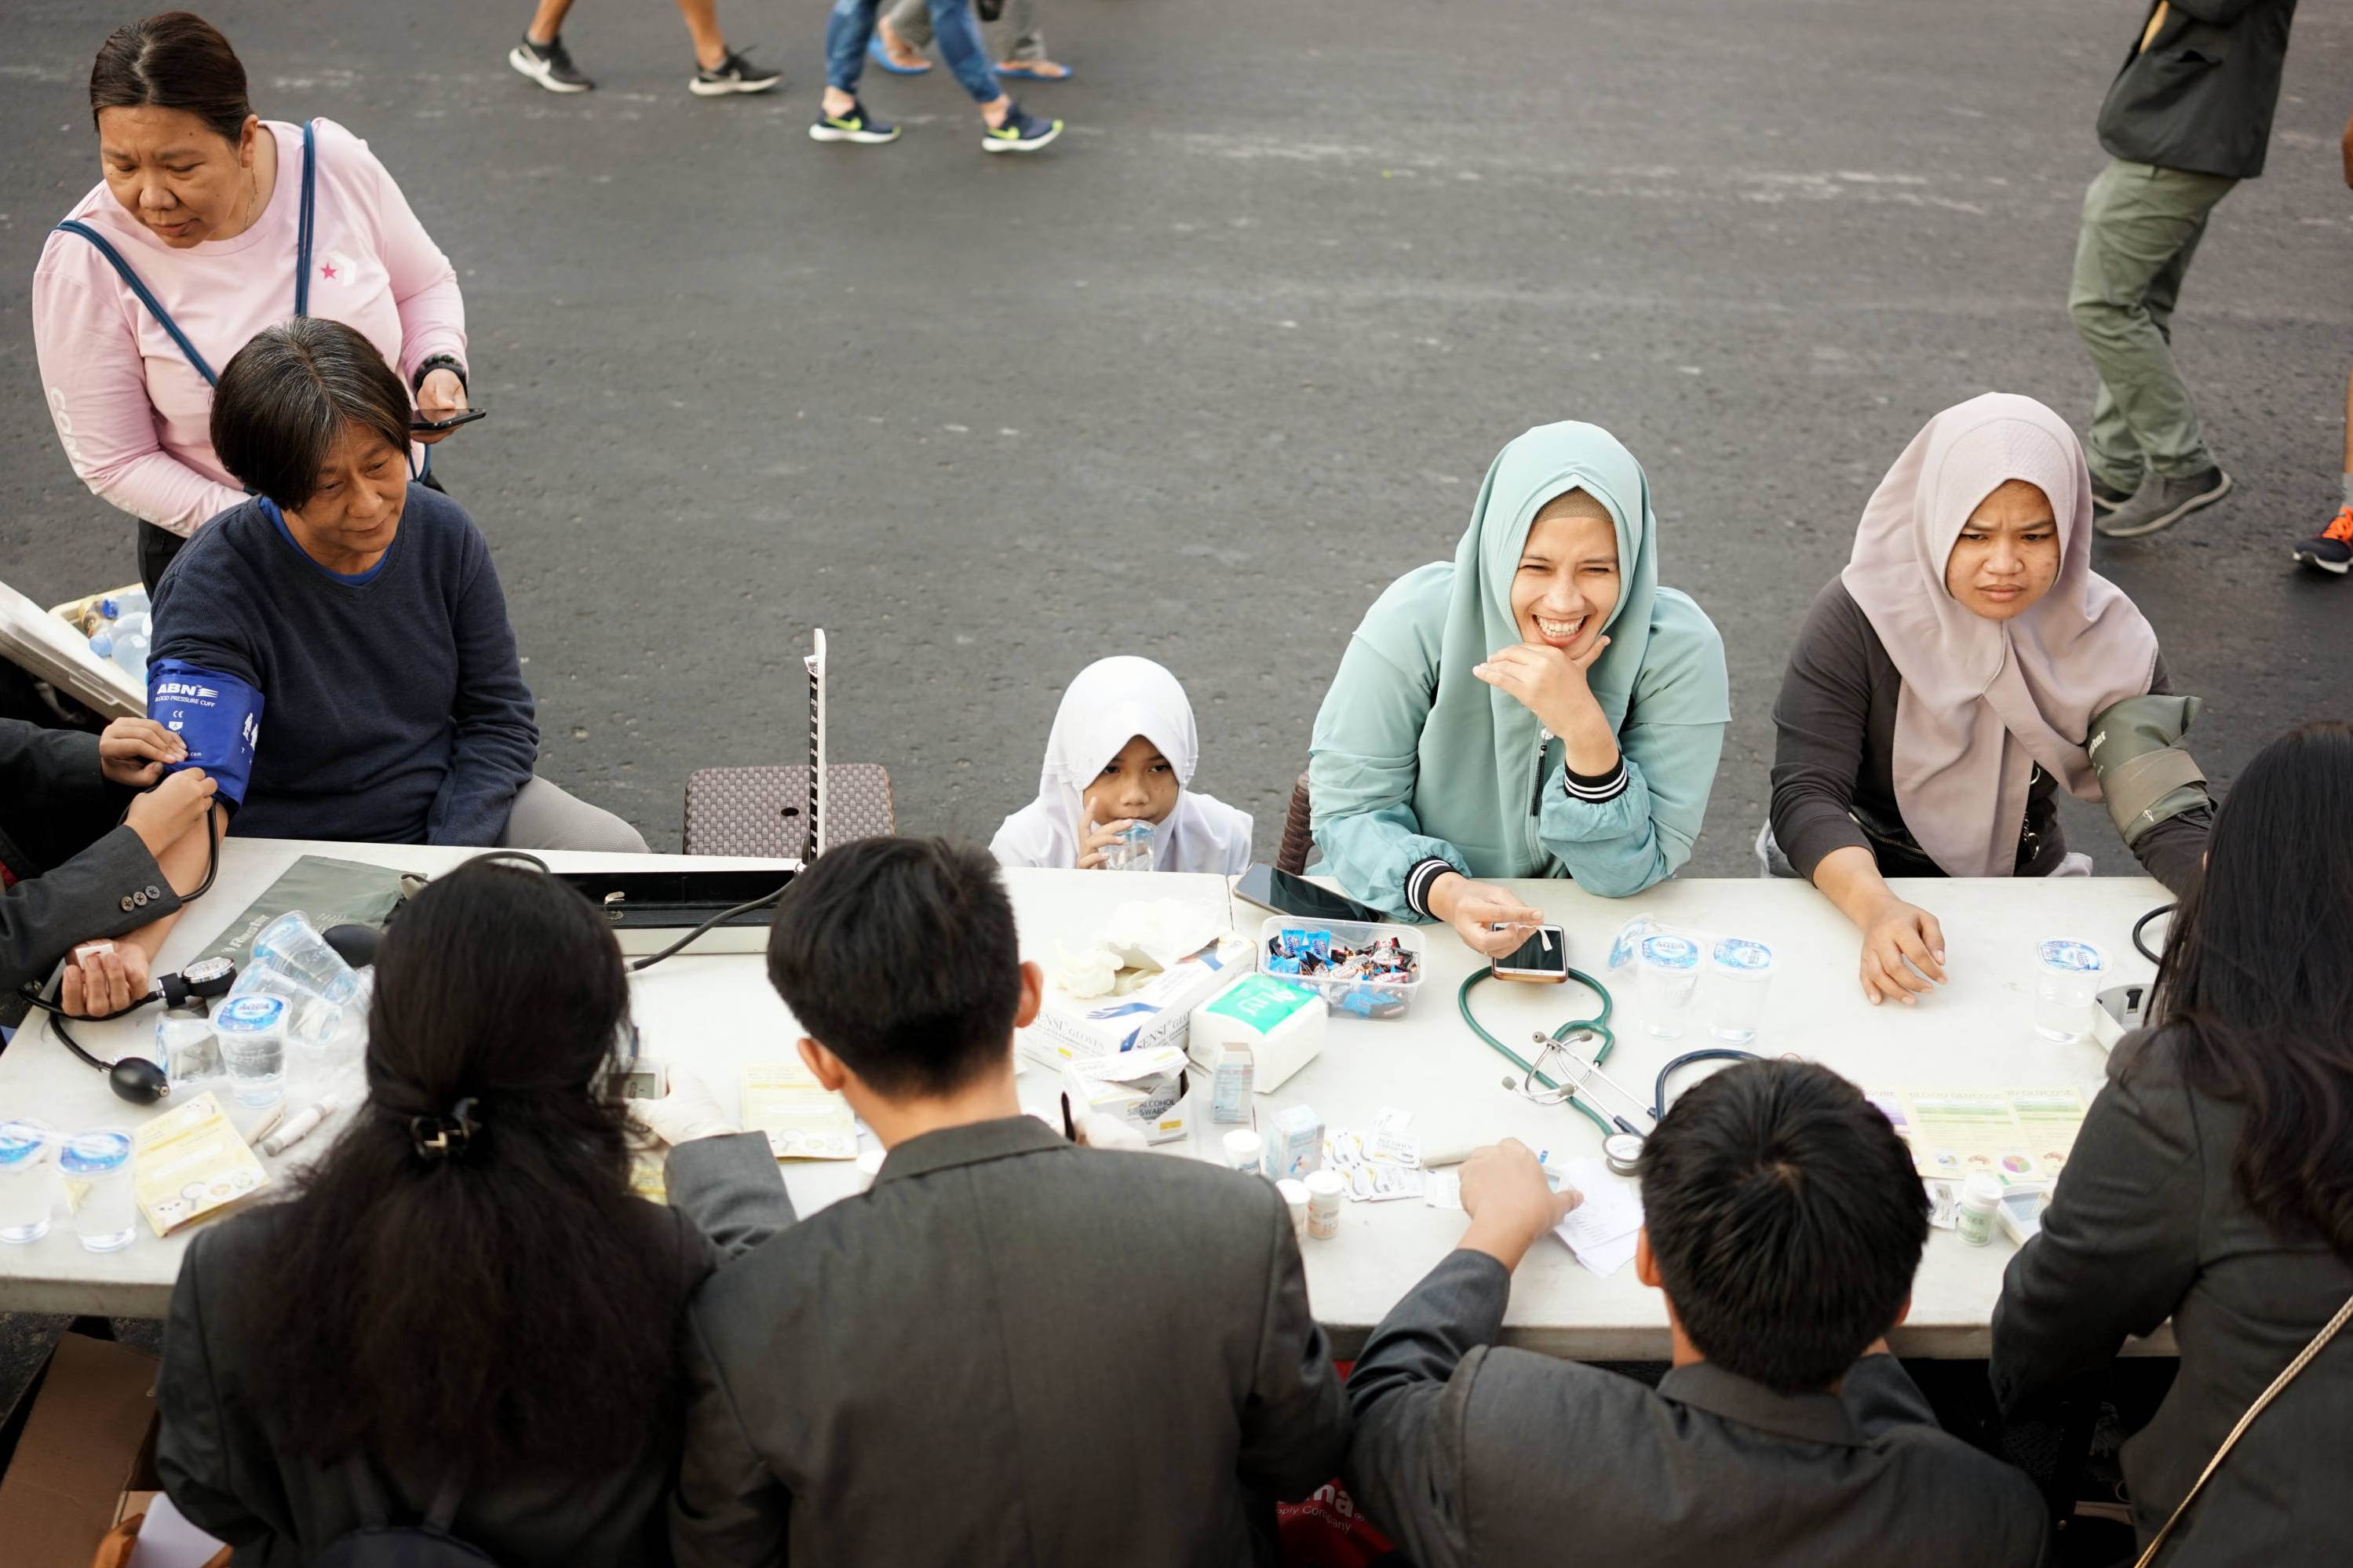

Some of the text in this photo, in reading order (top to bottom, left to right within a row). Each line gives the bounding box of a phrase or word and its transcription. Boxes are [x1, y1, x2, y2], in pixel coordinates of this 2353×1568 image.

[157, 683, 196, 696] ABN
[170, 695, 200, 705] PRESSURE
[200, 699, 217, 708] CUFF
[1140, 1098, 1176, 1108] ALCOHOL
[1302, 1505, 1352, 1534] Company
